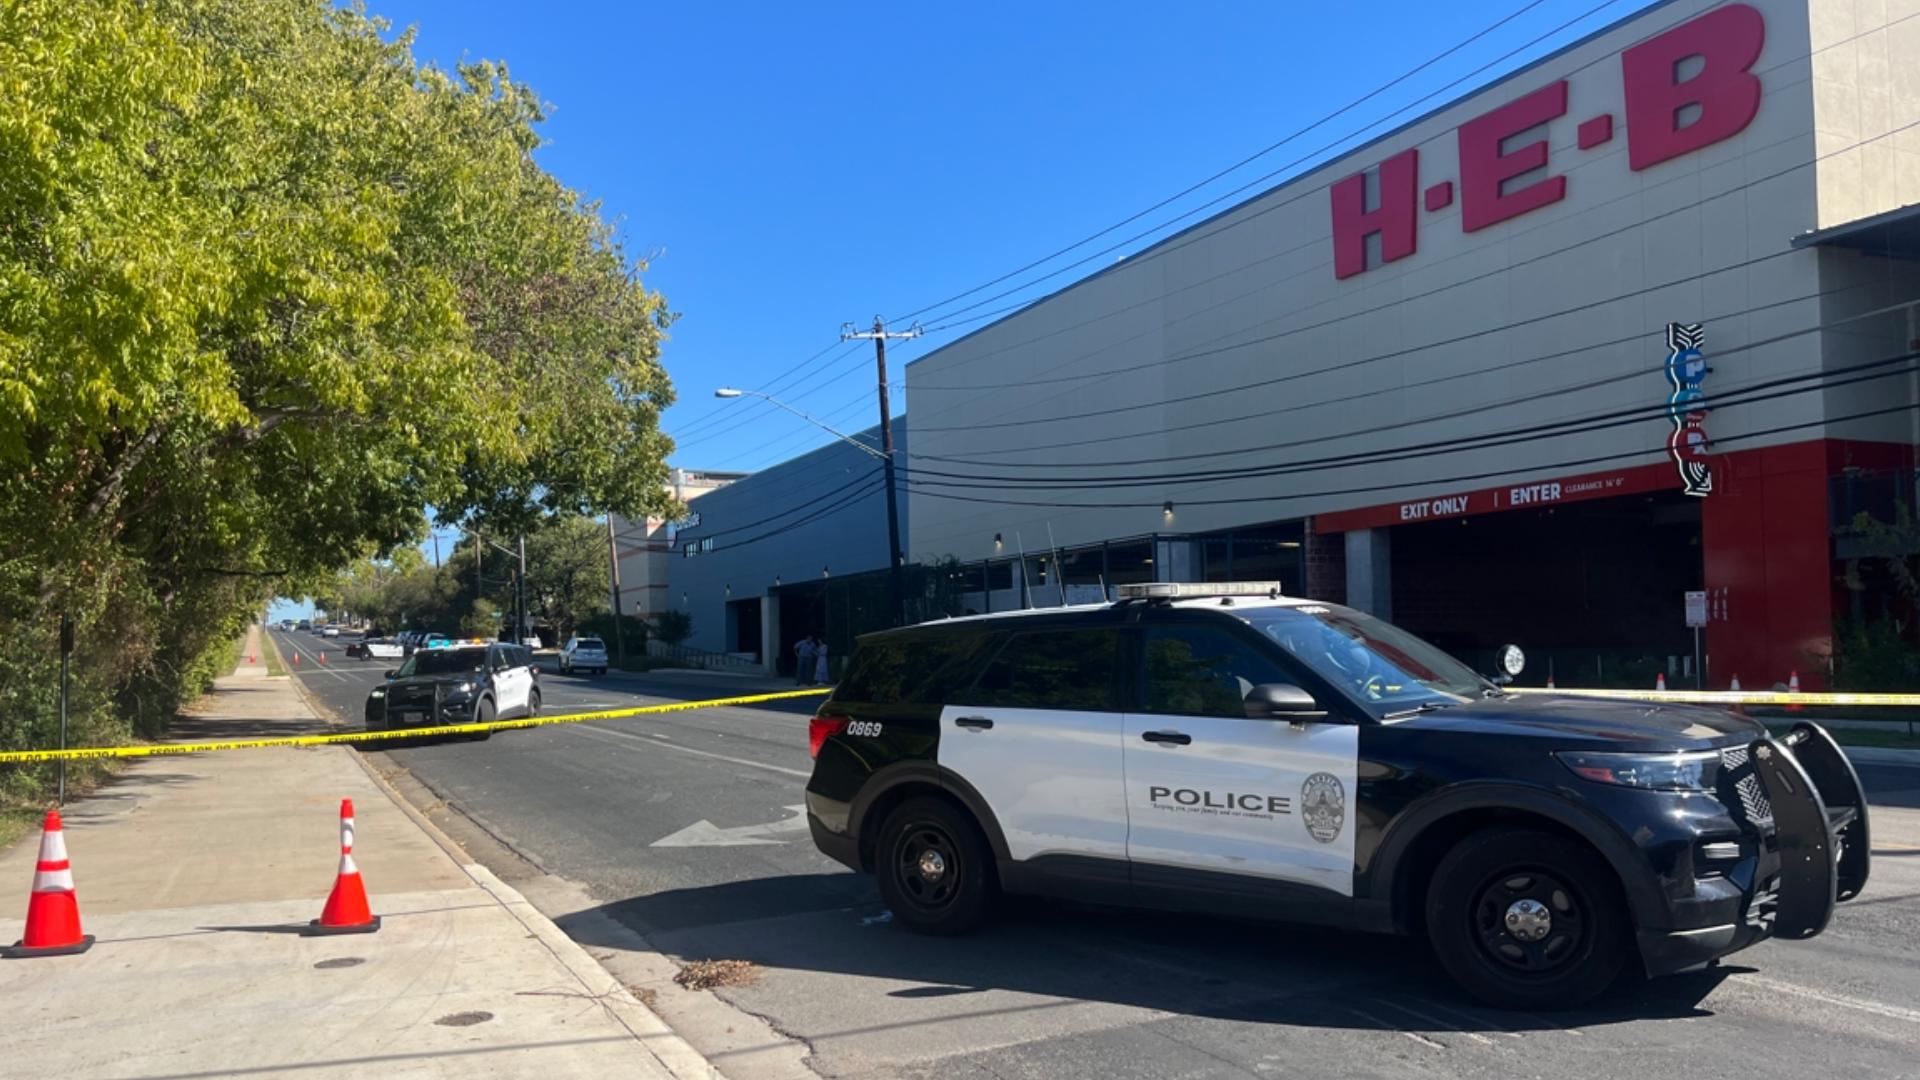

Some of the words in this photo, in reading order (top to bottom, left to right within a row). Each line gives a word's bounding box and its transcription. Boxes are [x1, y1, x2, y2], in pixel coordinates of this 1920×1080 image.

[1510, 483, 1562, 505] ENTER
[1401, 502, 1429, 520] EXIT
[1432, 496, 1468, 516] ONLY
[847, 721, 882, 737] 0869
[1150, 786, 1292, 814] POLICE
